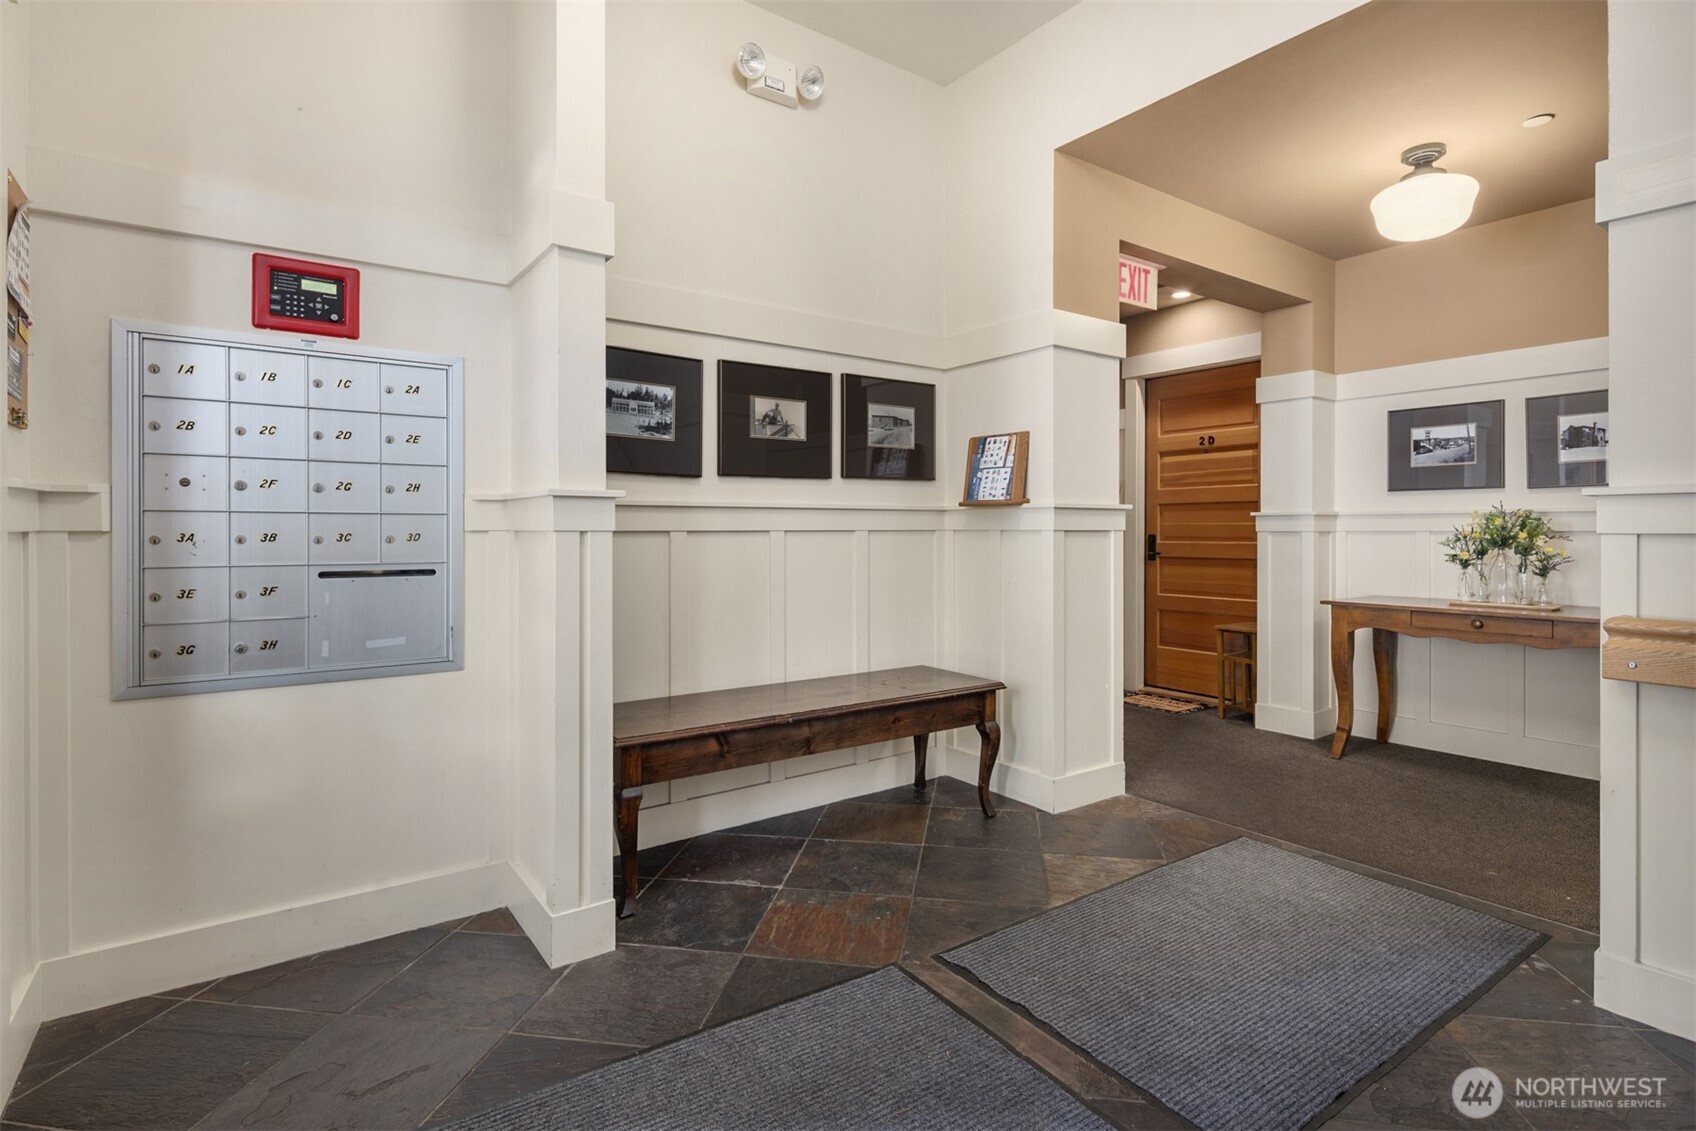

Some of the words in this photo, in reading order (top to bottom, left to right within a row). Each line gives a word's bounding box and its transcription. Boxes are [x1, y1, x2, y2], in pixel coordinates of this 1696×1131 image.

[1119, 262, 1151, 304] EXIT
[177, 364, 195, 375] 1A
[260, 372, 277, 382] 1B
[336, 379, 352, 389] 1C
[405, 385, 420, 394] 2A
[176, 420, 195, 431] 2B
[259, 425, 277, 435] 2C
[335, 430, 352, 440] 2D
[405, 434, 421, 444] 2E
[259, 479, 278, 489] 2F
[335, 481, 352, 492] 2G
[405, 483, 421, 493] 2H
[176, 532, 195, 543] 3A
[260, 532, 278, 543] 3B
[336, 533, 352, 543] 3C
[406, 532, 421, 542] 3D
[176, 588, 196, 599] 3E
[260, 586, 278, 596] 3F
[176, 644, 196, 656] 3G
[259, 640, 278, 651] 3H
